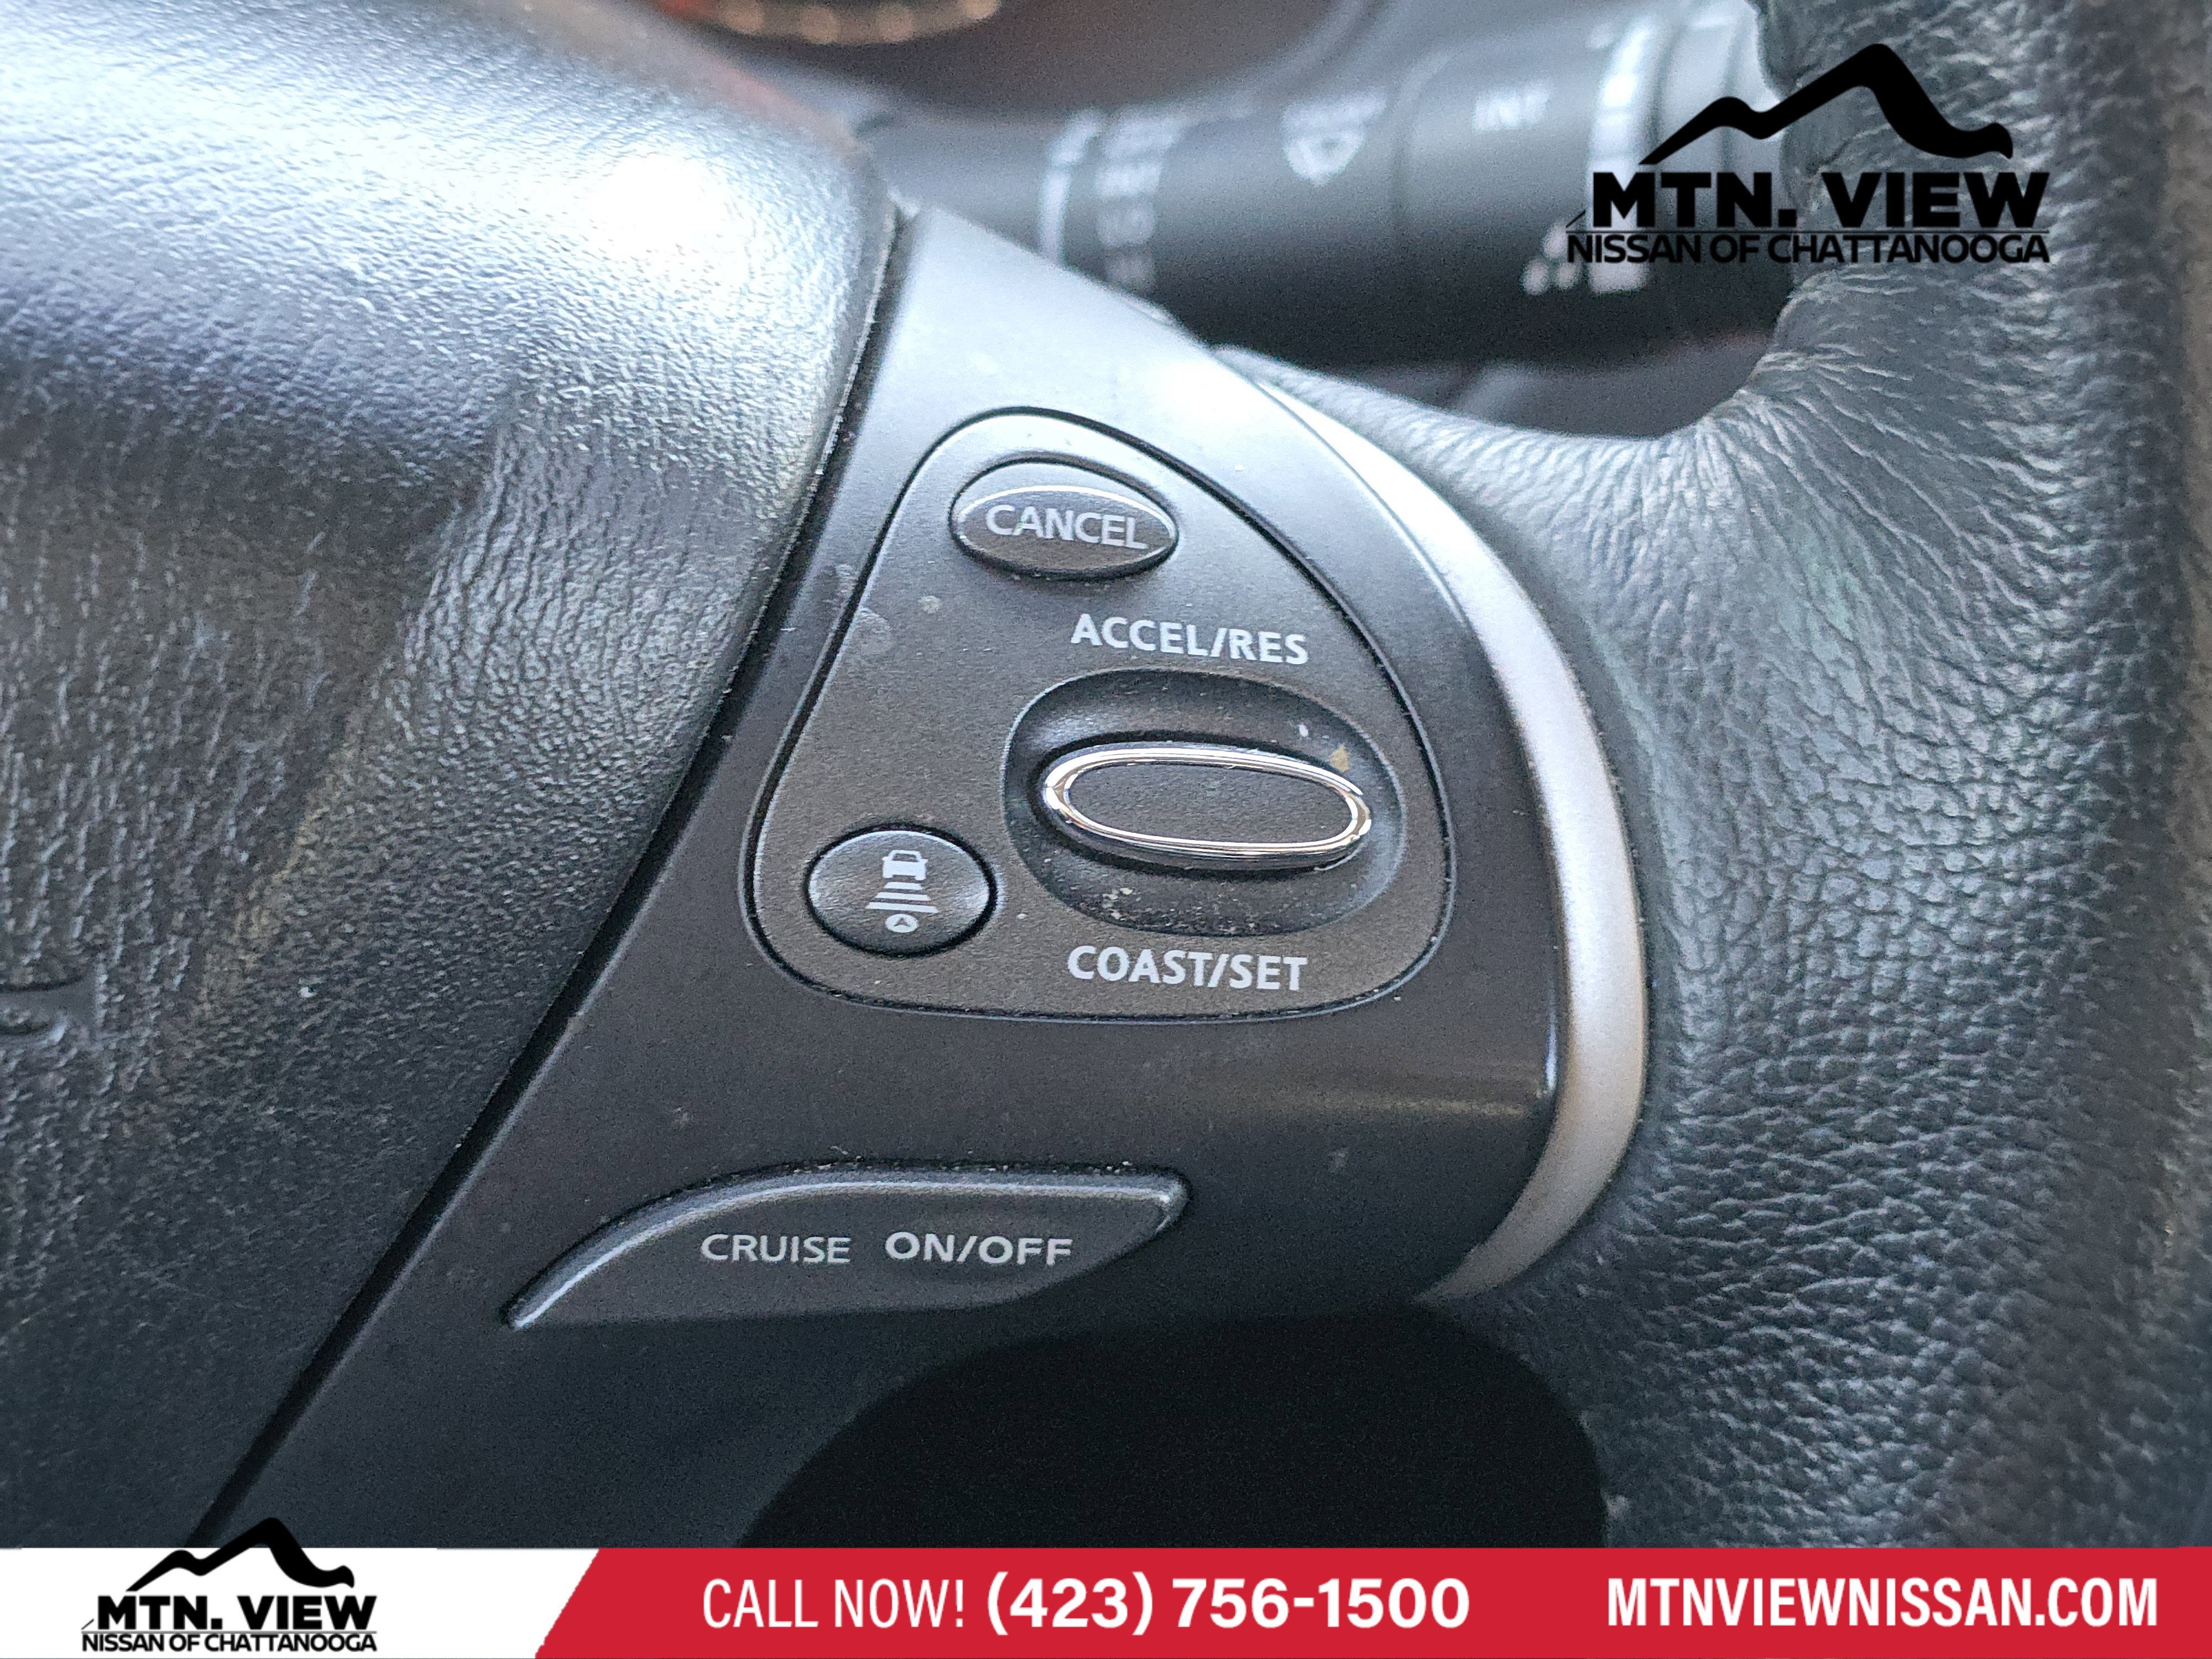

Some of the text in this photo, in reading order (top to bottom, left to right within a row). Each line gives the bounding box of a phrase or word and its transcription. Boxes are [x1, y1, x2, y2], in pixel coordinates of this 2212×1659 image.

[985, 503, 1149, 550] CANCEL
[1070, 613, 1309, 665] ACCEL/RES
[1067, 944, 1309, 992] COAST/SET
[701, 1232, 1073, 1265] CRUISE ON/OFF
